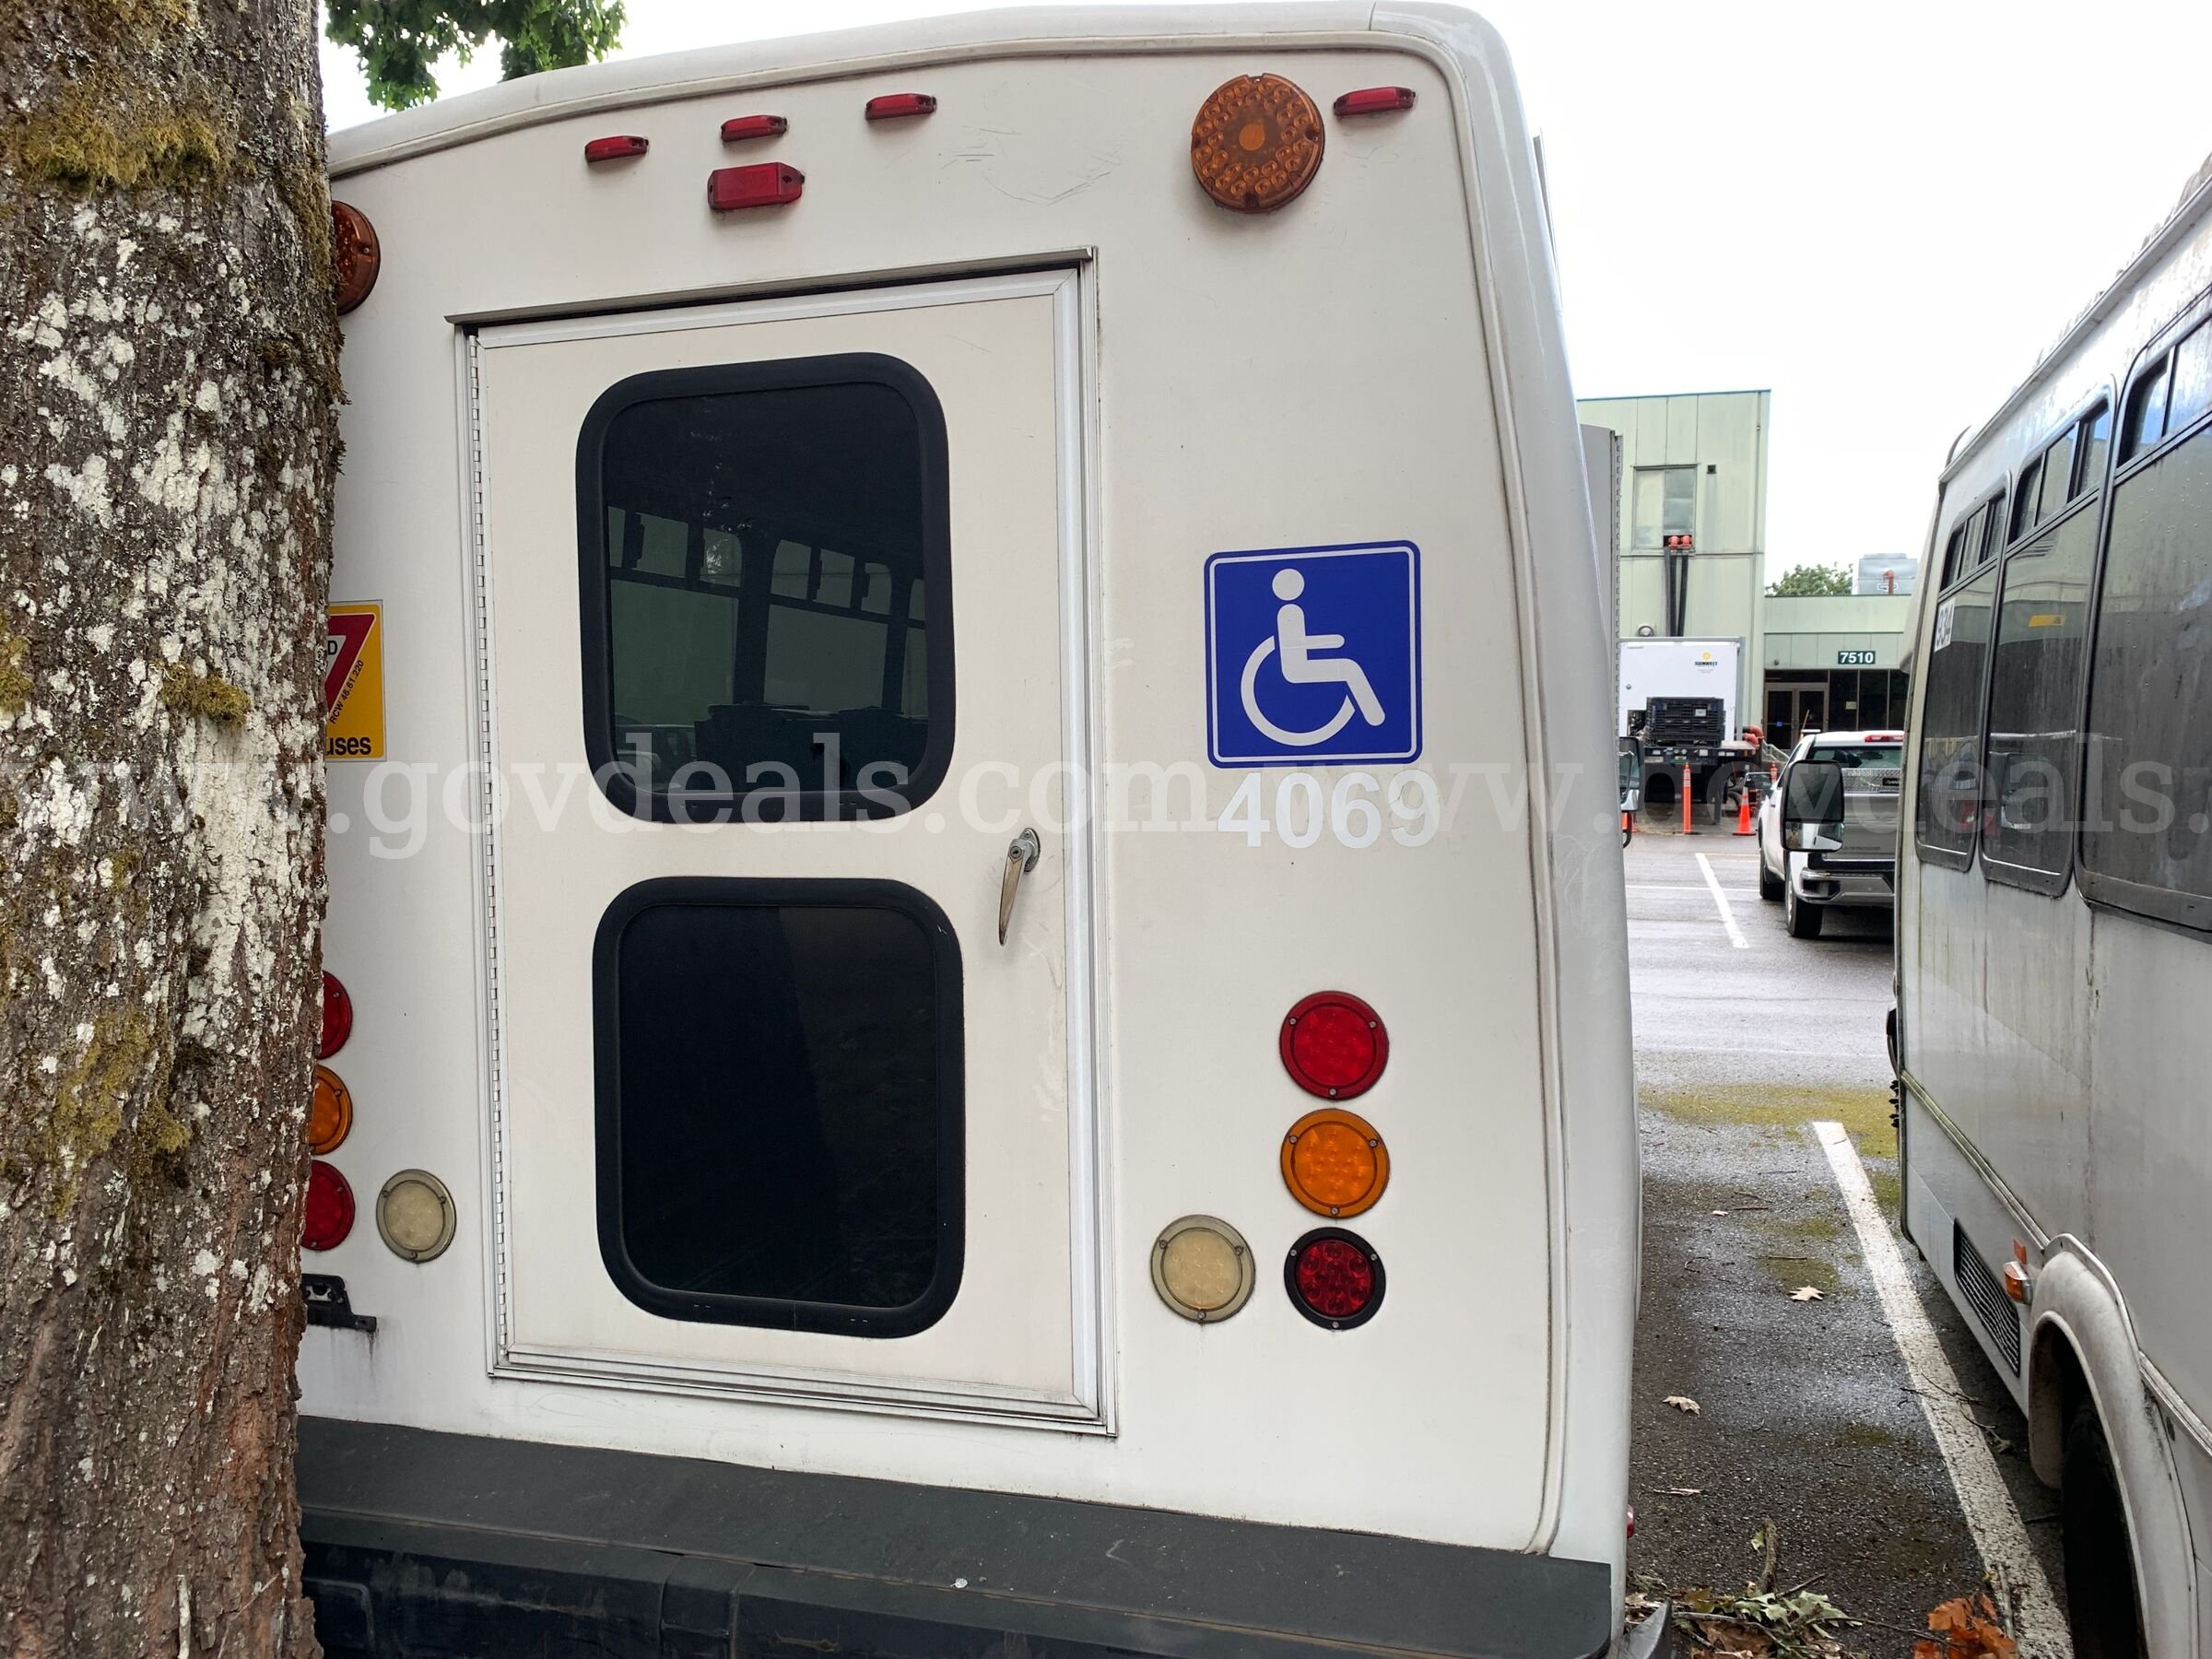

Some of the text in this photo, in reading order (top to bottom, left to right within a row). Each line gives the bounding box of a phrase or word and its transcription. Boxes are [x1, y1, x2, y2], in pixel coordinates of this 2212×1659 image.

[1840, 652, 1874, 664] 7510
[329, 659, 364, 724] RCW 46.61.220
[324, 736, 371, 756] uses
[1218, 771, 1441, 849] 4069
